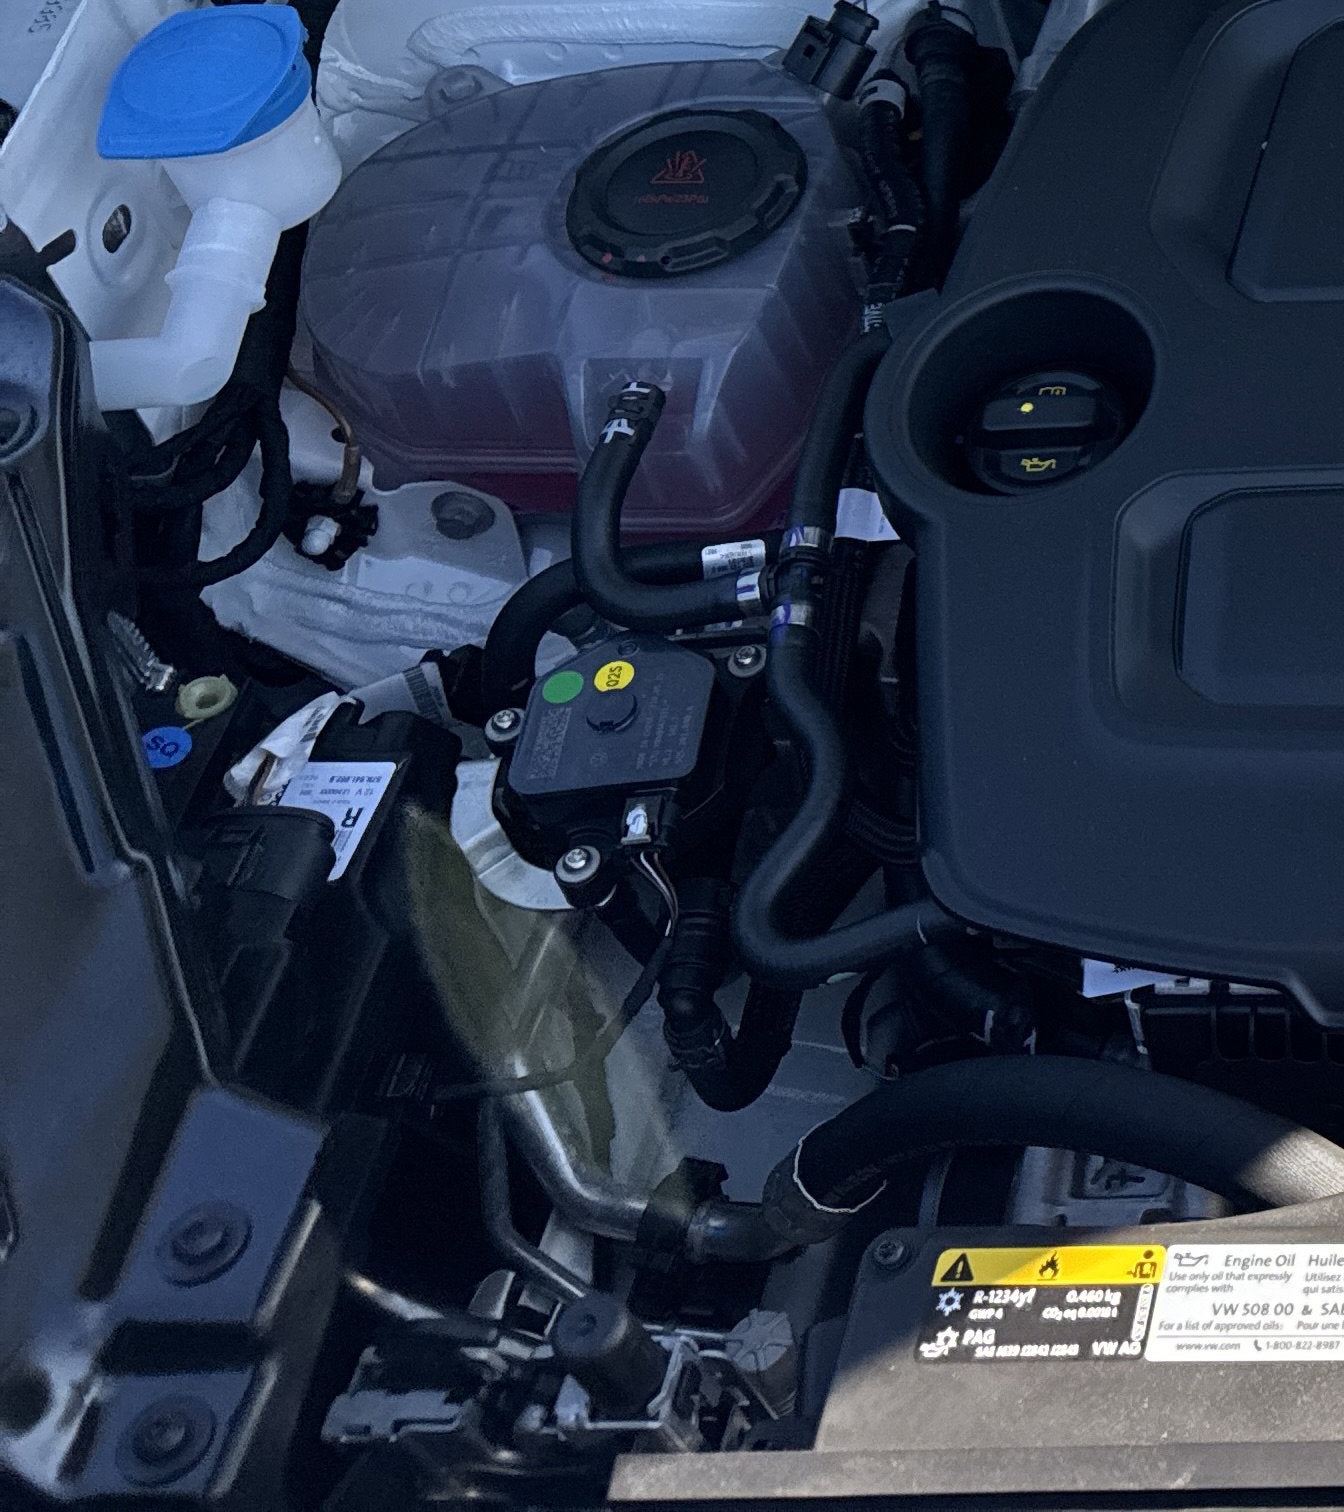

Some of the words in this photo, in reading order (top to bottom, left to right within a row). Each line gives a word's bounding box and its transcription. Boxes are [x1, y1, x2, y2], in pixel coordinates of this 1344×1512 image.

[341, 807, 364, 828] R
[1224, 1254, 1272, 1270] Engine
[1276, 1253, 1296, 1266] Oil
[1308, 1254, 1344, 1267] Huile
[1169, 1272, 1187, 1281] Use
[1189, 1273, 1210, 1282] only
[1211, 1272, 1223, 1281] oil
[1225, 1272, 1246, 1281] that
[1247, 1271, 1293, 1282] expressly
[1305, 1272, 1341, 1282] Utilisez
[1166, 1284, 1209, 1294] complies
[1212, 1284, 1234, 1293] with
[1302, 1284, 1320, 1296] qui
[1212, 1303, 1239, 1316] VW
[1242, 1303, 1270, 1316] 508
[1274, 1303, 1294, 1316] 00
[1301, 1305, 1313, 1315] &
[1158, 1321, 1176, 1331] For
[1176, 1323, 1183, 1331] a
[1185, 1321, 1200, 1331] list
[1201, 1321, 1213, 1331] of
[1214, 1321, 1261, 1332] approved
[1296, 1321, 1320, 1330] Pour
[1321, 1322, 1340, 1330] une
[962, 1329, 996, 1345] PAG
[1091, 1341, 1118, 1356] VW
[1118, 1341, 1142, 1356] AG
[1176, 1342, 1241, 1351] www.vw.com
